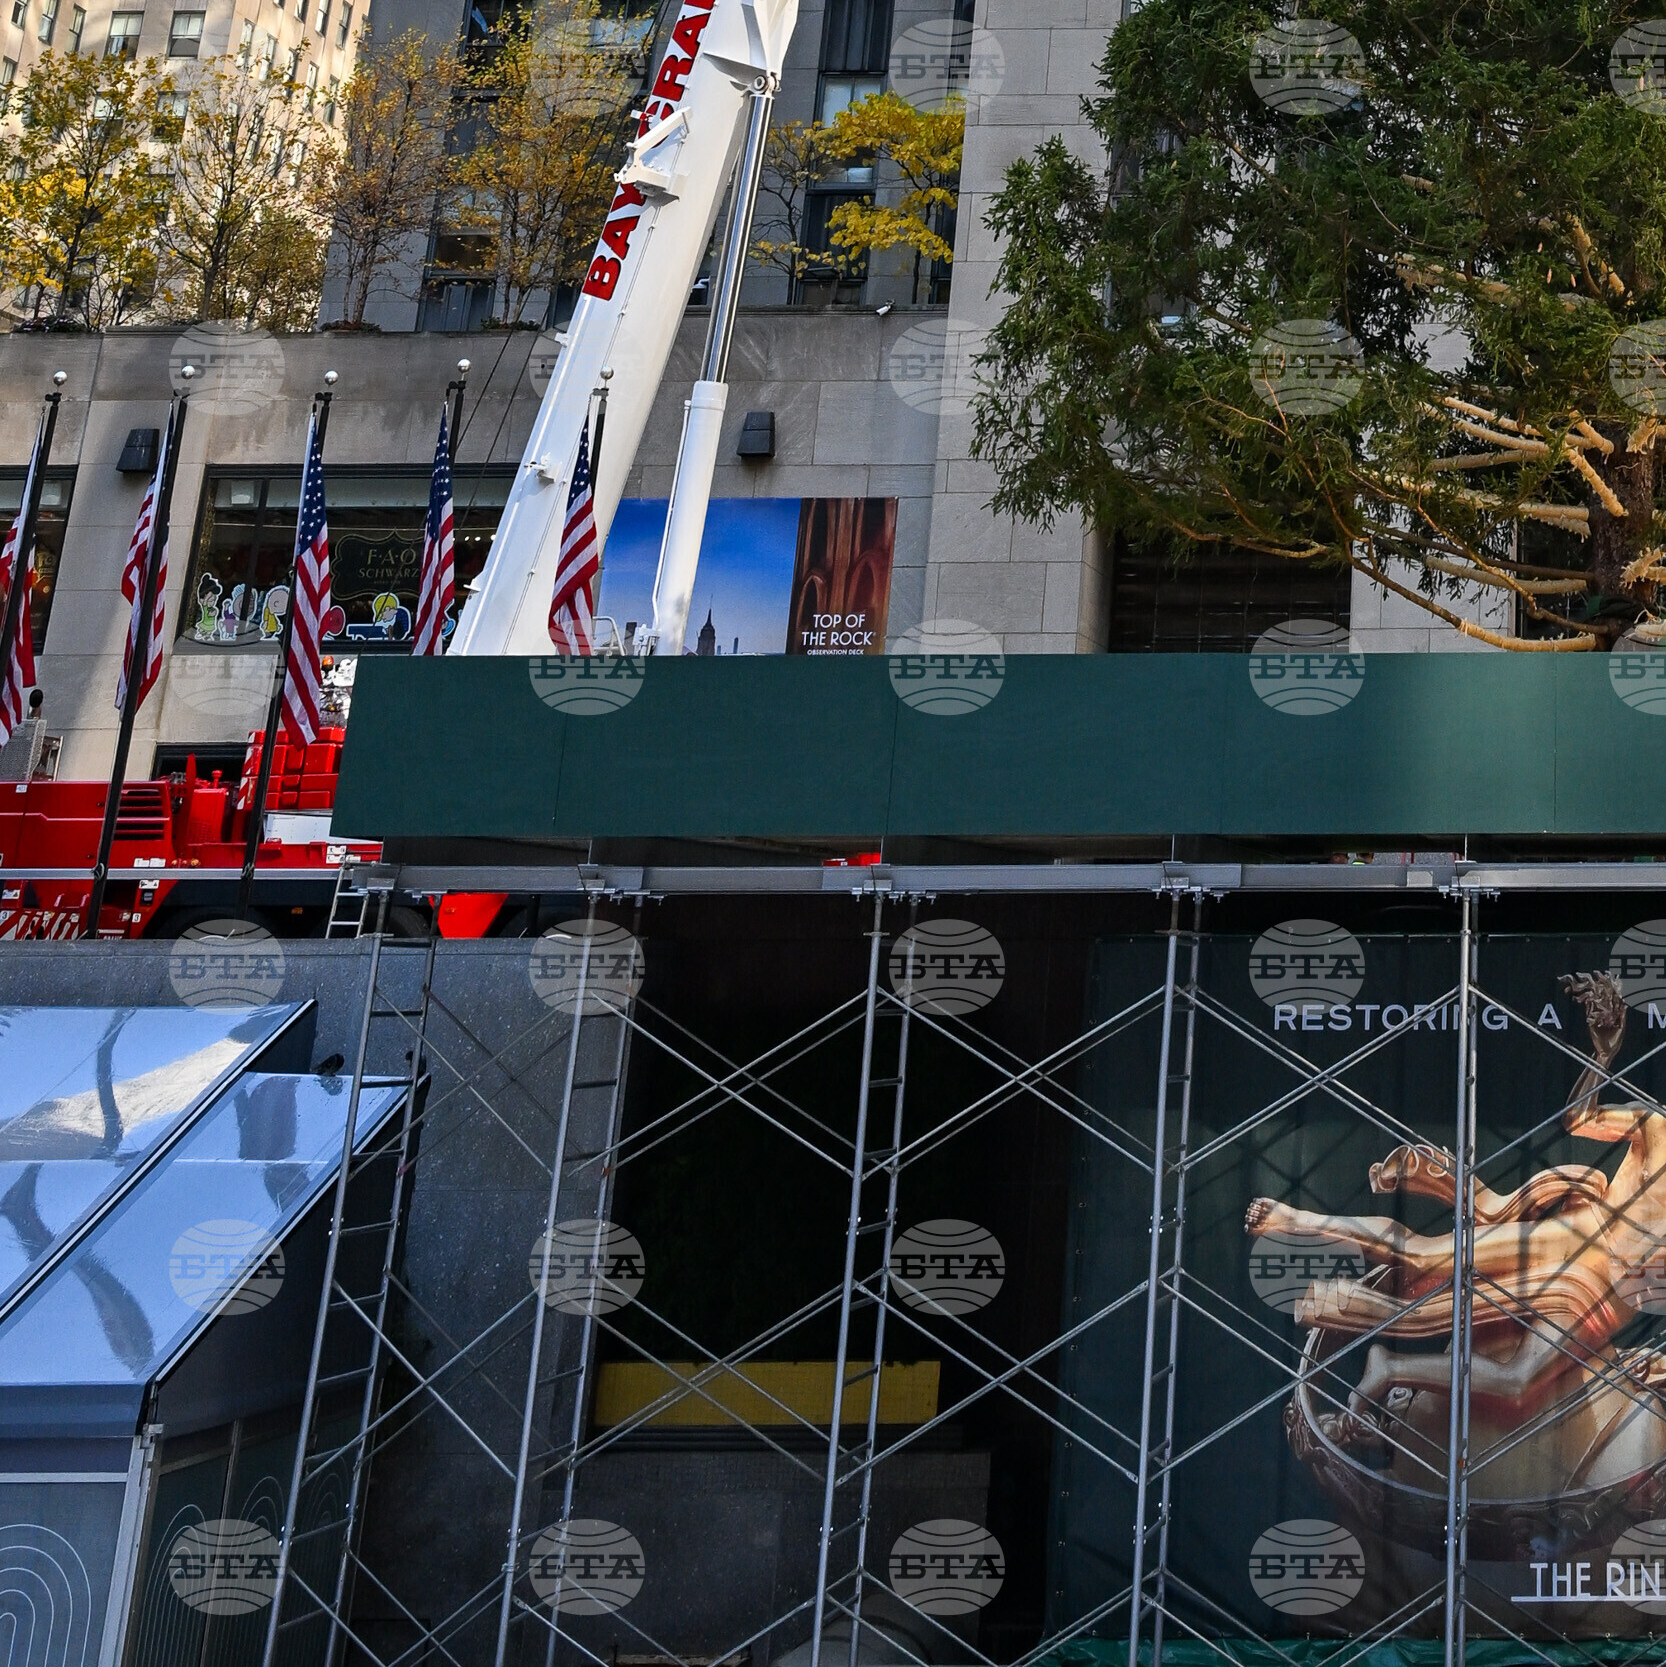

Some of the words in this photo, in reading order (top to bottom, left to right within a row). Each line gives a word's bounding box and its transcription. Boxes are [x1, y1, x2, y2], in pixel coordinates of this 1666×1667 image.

[582, 175, 647, 301] BAY
[358, 567, 421, 579] SCHWARZ
[813, 613, 842, 628] TOP
[845, 613, 866, 628] OF
[801, 631, 827, 646] THE
[806, 648, 848, 656] OBSERVATION
[848, 648, 864, 656] DECK
[1537, 1003, 1563, 1030] A
[1529, 1562, 1591, 1598] THE
